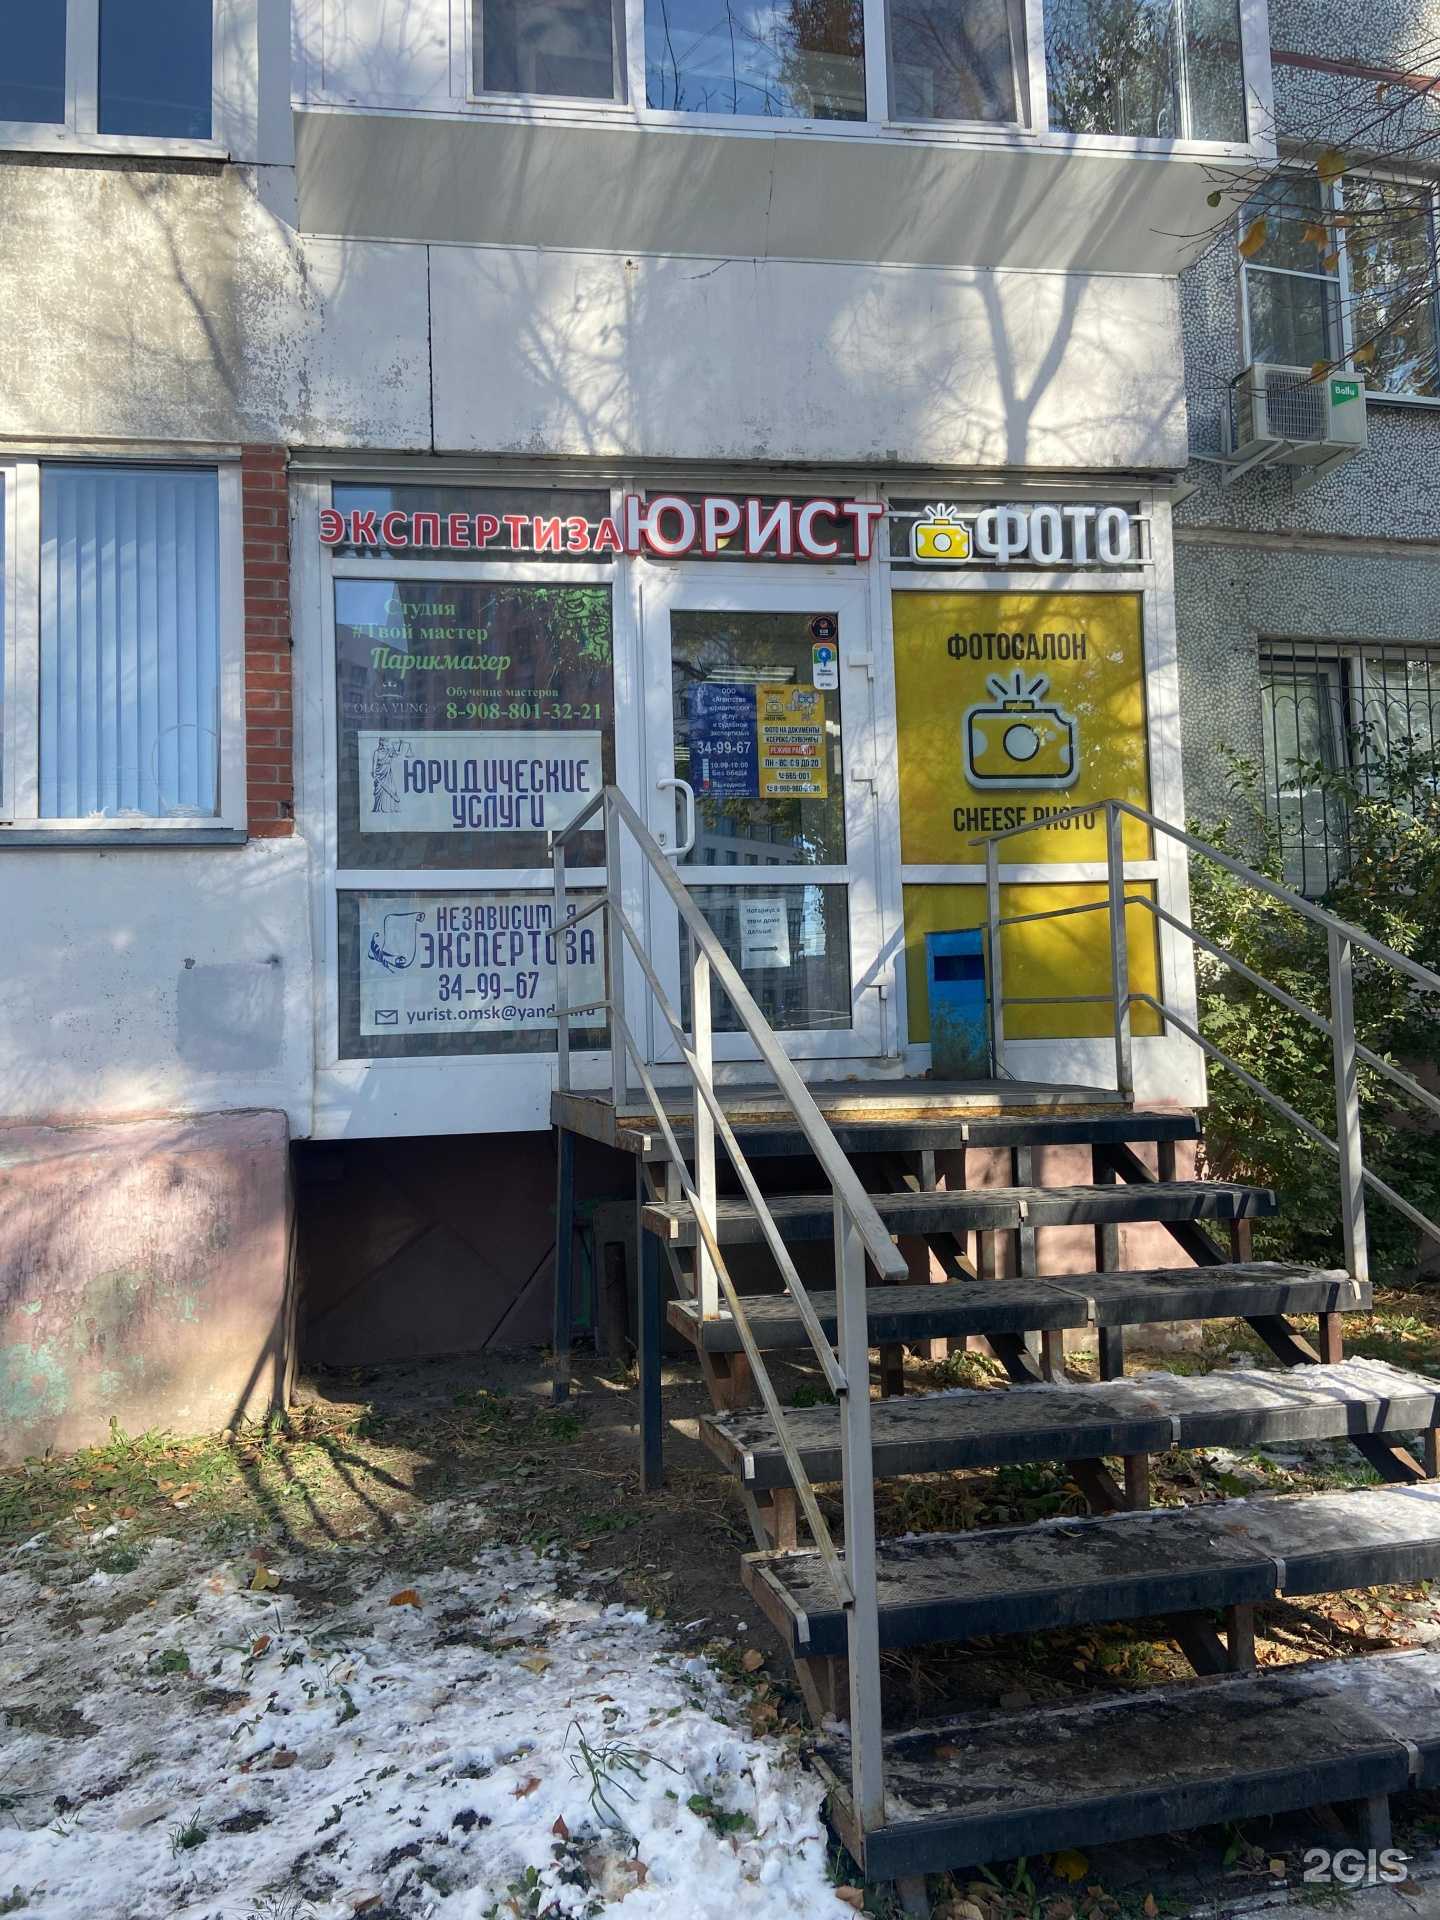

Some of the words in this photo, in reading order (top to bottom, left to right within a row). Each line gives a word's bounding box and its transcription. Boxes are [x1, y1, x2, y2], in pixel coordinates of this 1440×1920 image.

[1334, 386, 1356, 396] Ballu
[319, 508, 624, 554] ЭКСПЕРТИЗА
[624, 495, 884, 561] ЮРИСТ
[975, 505, 1131, 566] ФОТО
[384, 598, 457, 619] Студия
[420, 627, 489, 644] мастер
[947, 632, 1087, 661] ФОТОСАЛОН
[370, 647, 511, 681] Парикмахер
[446, 686, 502, 699] Обучение
[505, 688, 559, 699] мастеров
[446, 703, 602, 720] 8-908-801-32-21
[697, 740, 752, 754] 34-99-67
[404, 758, 590, 794] ЮРИДИЧЕСКИЕ
[452, 794, 545, 829] УСЛУГИ
[437, 904, 577, 932] НЕЗАВИСИМЯ
[438, 972, 540, 1001] 34-99-67
